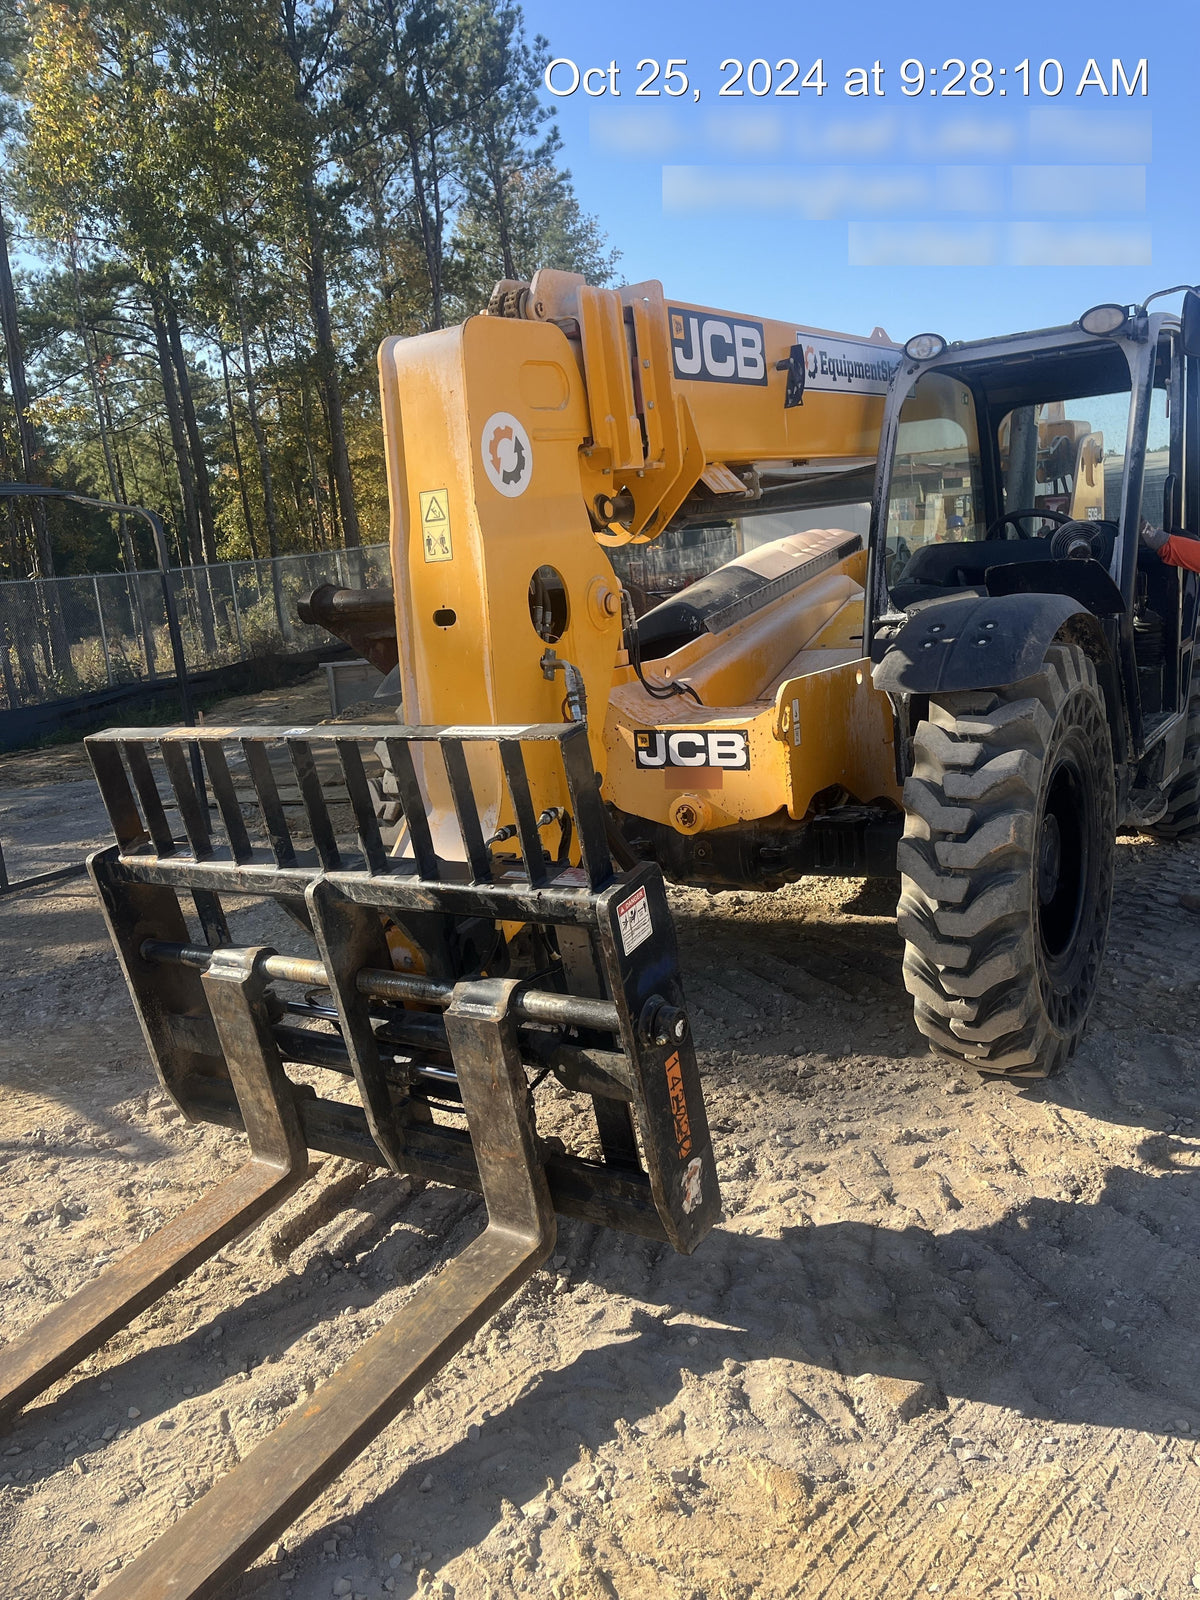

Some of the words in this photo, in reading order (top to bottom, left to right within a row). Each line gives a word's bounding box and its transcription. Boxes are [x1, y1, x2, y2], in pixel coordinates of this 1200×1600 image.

[674, 317, 766, 380] JCB
[819, 350, 894, 383] EquipmentSh
[638, 732, 748, 767] JCB
